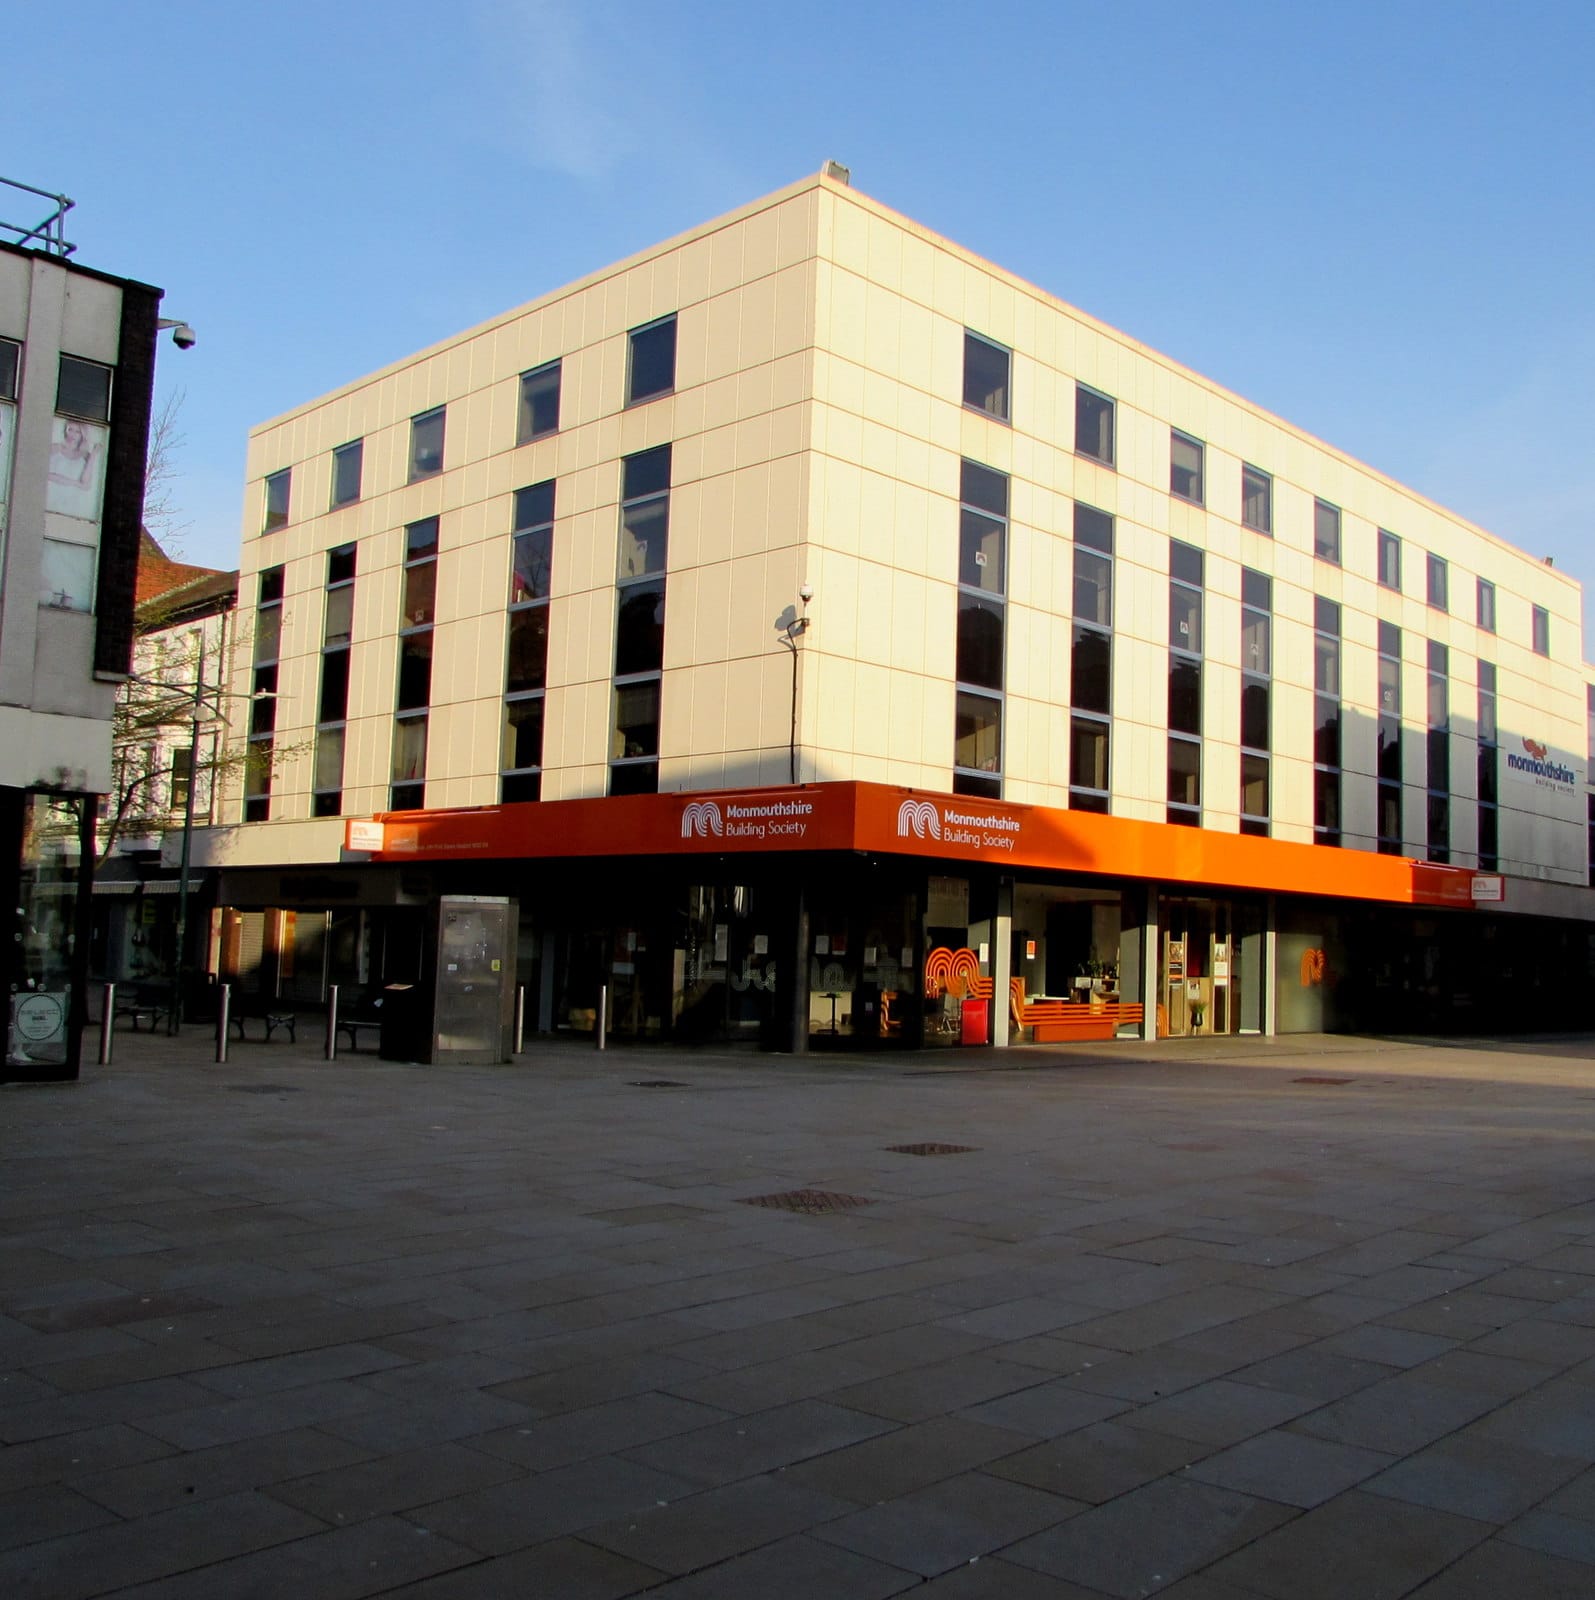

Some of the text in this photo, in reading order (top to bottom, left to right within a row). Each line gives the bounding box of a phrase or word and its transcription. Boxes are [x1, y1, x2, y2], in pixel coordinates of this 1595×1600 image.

[1508, 754, 1575, 785] monmouthshire
[727, 800, 813, 818] Monmouthshire
[944, 809, 1020, 832] Monmouthshire
[726, 820, 807, 839] Building Society
[944, 827, 1015, 852] Building Society
